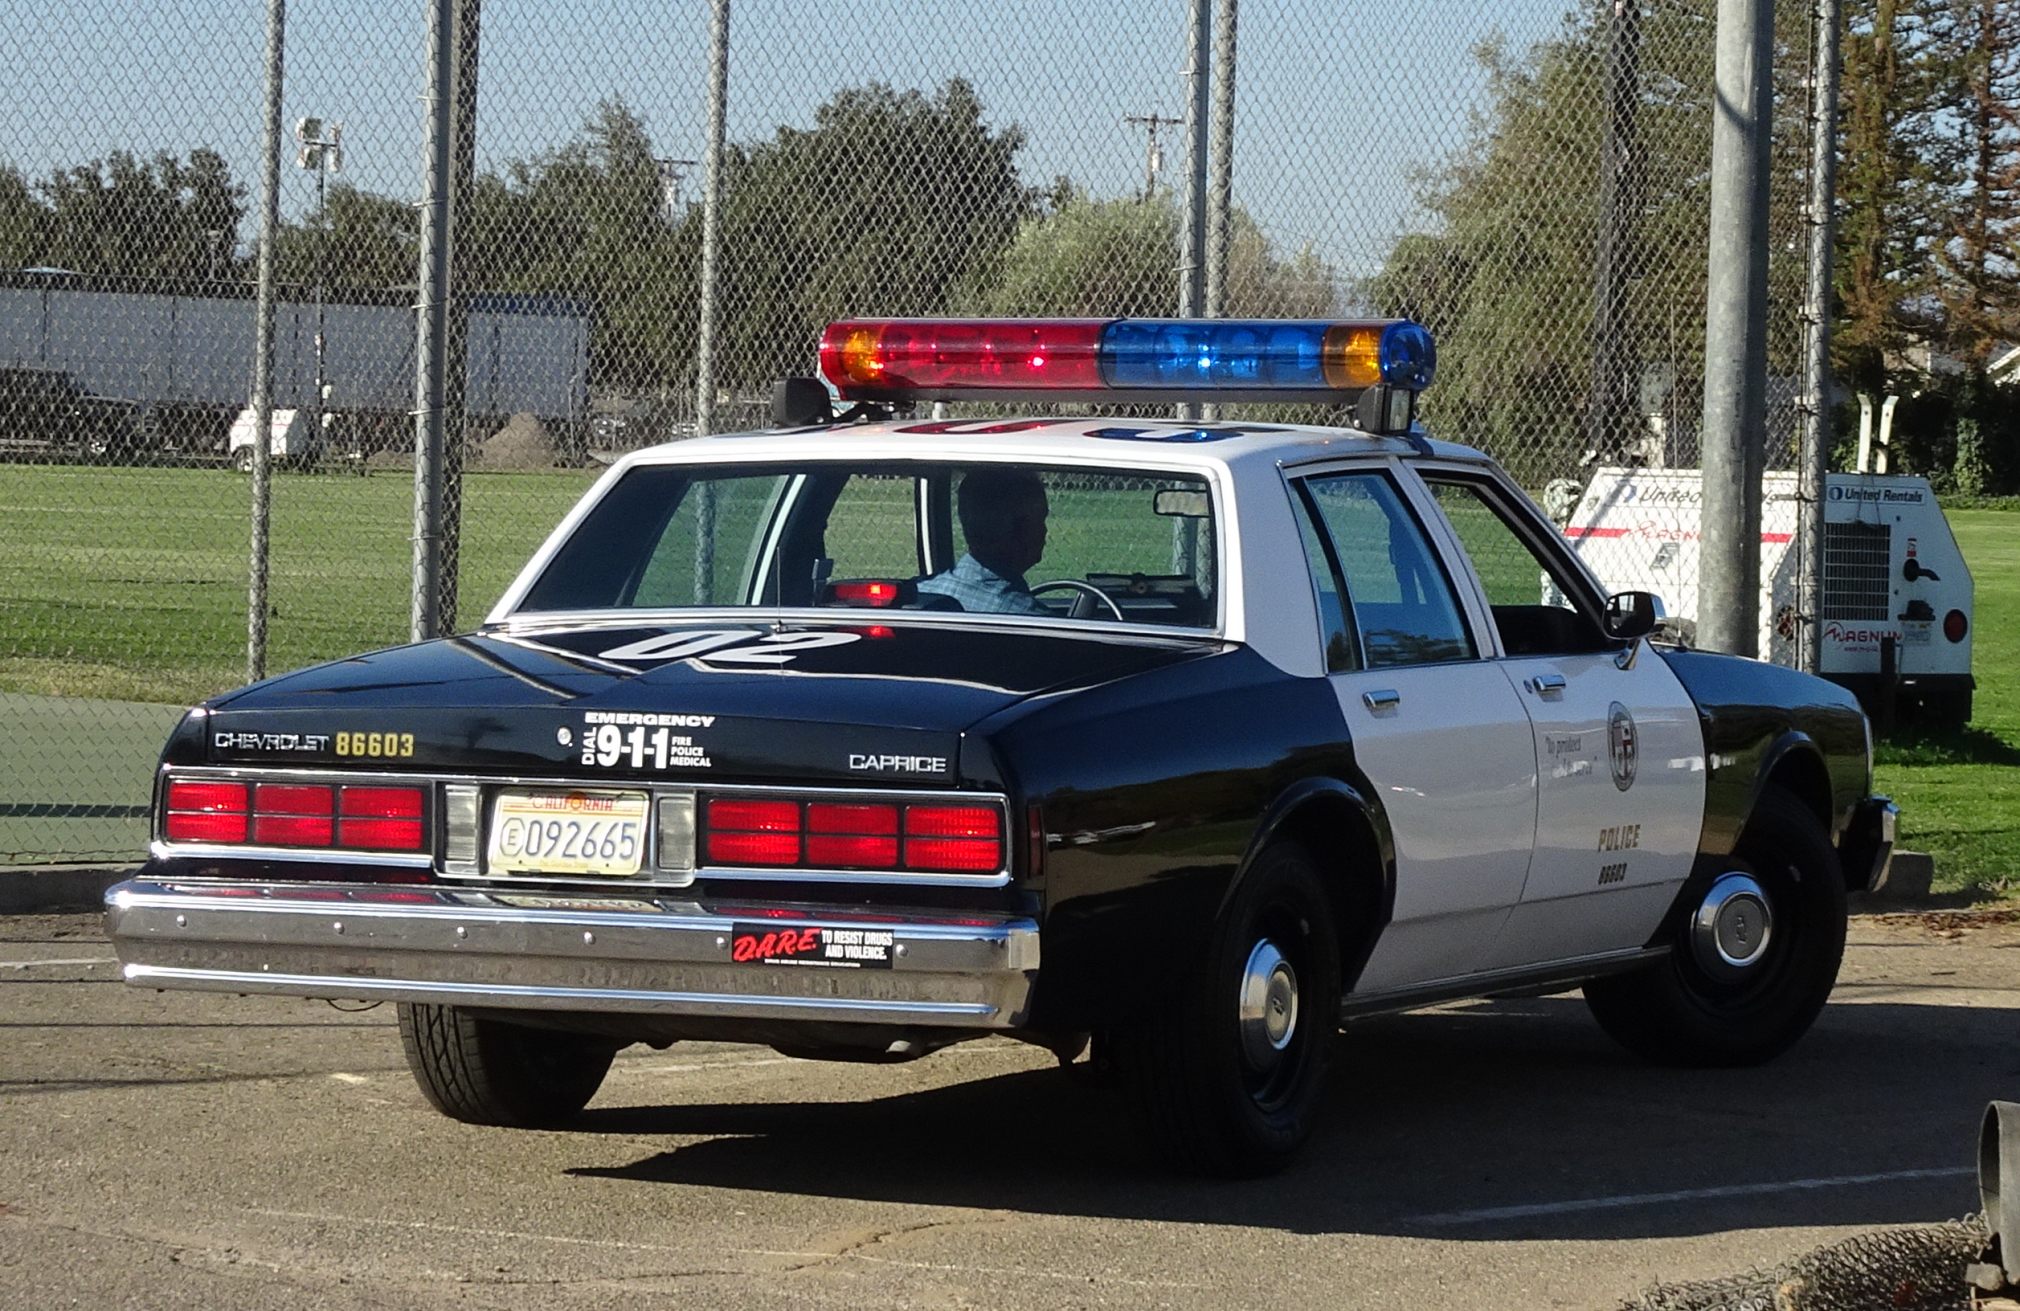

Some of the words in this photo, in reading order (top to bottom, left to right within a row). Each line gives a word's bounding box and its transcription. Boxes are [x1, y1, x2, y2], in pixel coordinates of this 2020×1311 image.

[1845, 487, 1881, 501] United
[1883, 489, 1923, 503] Rentals
[598, 630, 862, 663] 02
[585, 712, 715, 727] EMERGENCY
[215, 732, 330, 750] CHEVROLET
[336, 732, 414, 757] 86603
[581, 727, 597, 765] DIAL
[597, 724, 669, 769] 9-1-1
[671, 736, 693, 747] FIRE
[670, 747, 704, 757] POLICE
[669, 757, 712, 767] MEDICAL
[849, 754, 947, 773] CAPRICE
[532, 795, 614, 812] CALIFORNIA
[525, 820, 637, 860] 092665
[1598, 824, 1641, 852] POLICE
[1598, 863, 1628, 885] 86603
[822, 930, 831, 944] TO
[833, 931, 864, 945] RESIST
[864, 932, 893, 946] DRUGS
[825, 945, 845, 958] AND
